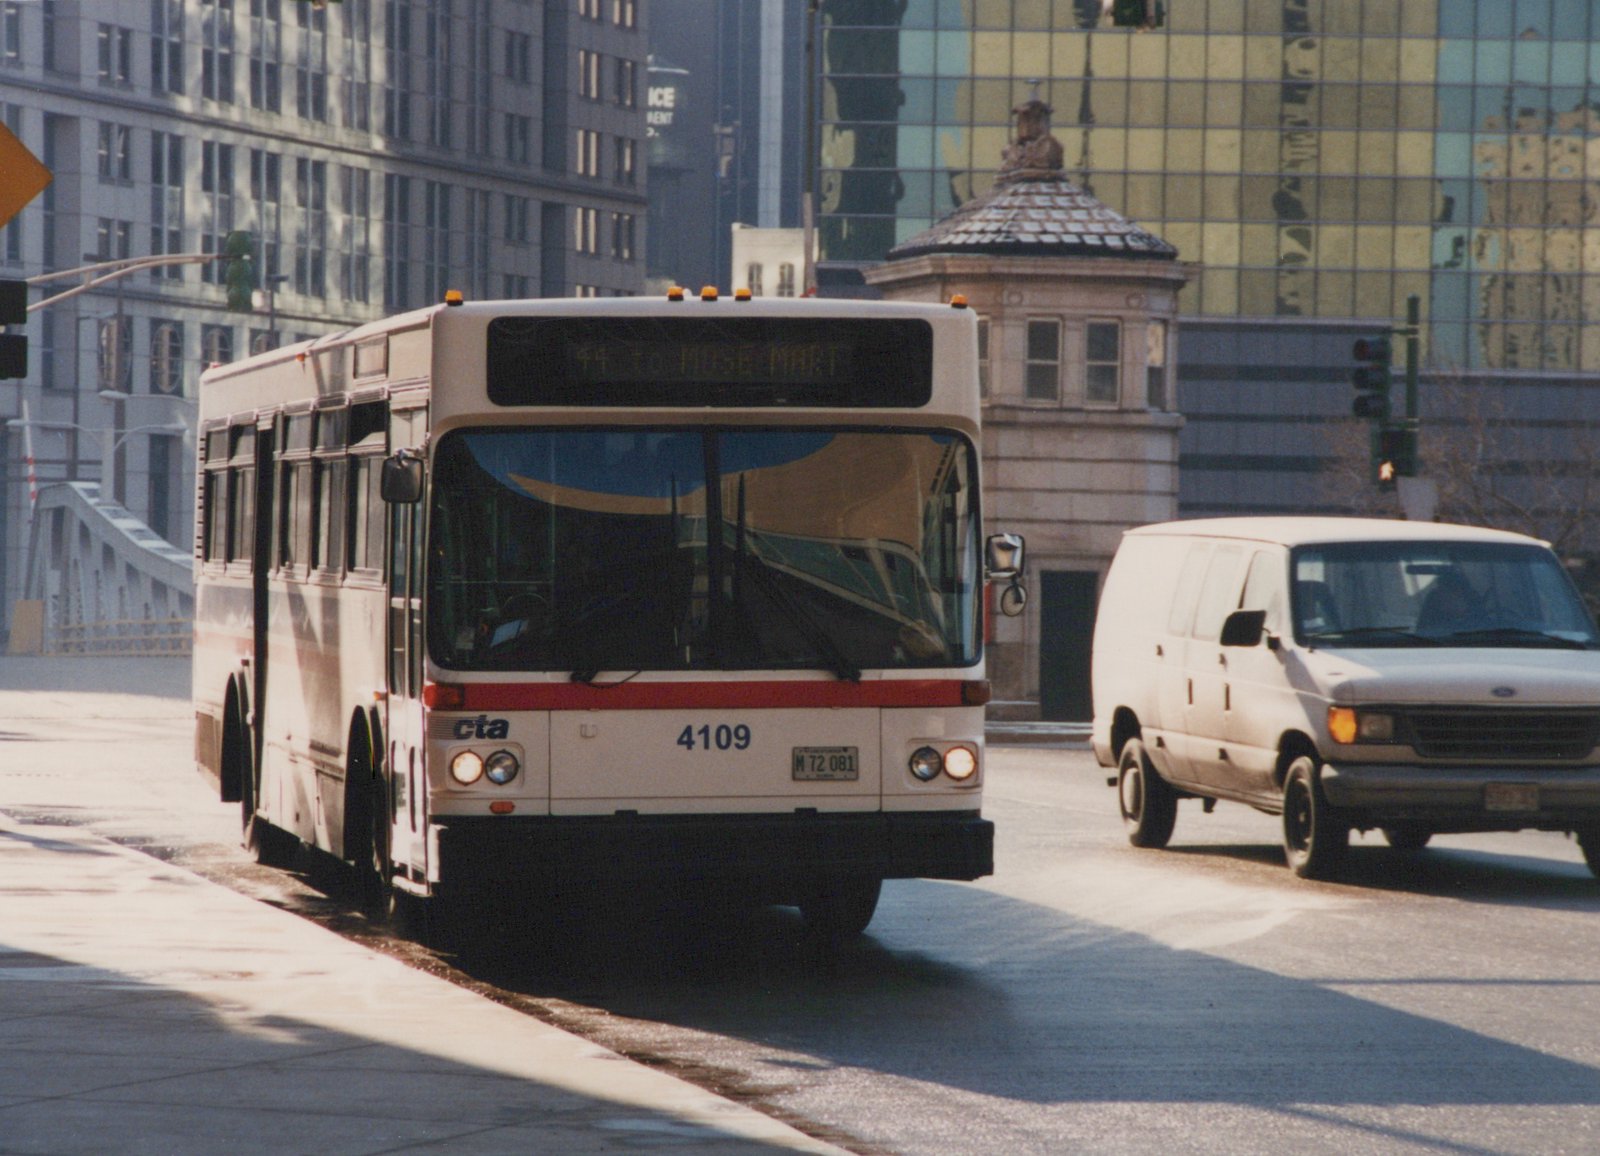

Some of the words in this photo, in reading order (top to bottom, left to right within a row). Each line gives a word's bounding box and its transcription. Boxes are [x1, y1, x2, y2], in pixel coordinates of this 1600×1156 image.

[453, 714, 510, 740] cta
[677, 724, 751, 750] 4109
[809, 754, 825, 772] 72
[829, 754, 855, 772] 081
